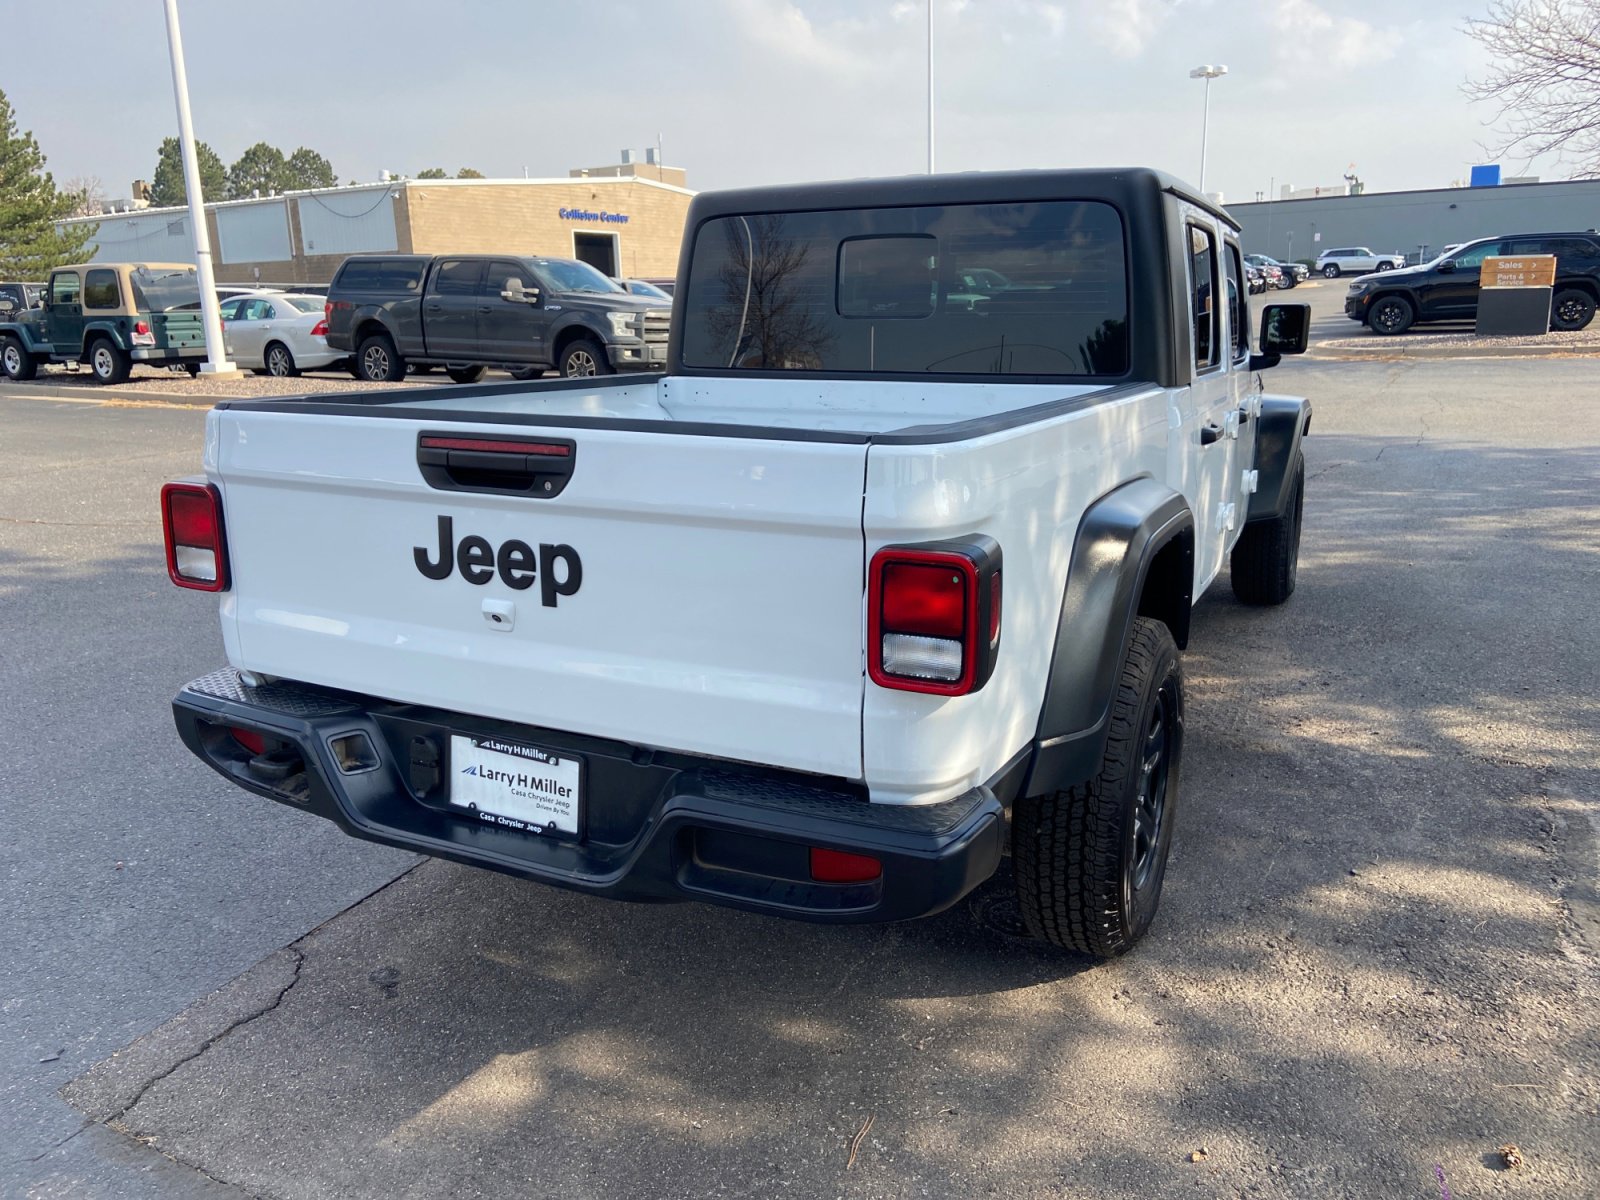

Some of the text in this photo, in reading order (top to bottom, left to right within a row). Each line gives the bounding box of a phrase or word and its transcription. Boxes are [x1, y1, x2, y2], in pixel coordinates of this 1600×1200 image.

[559, 208, 629, 223] Collision Center
[1498, 261, 1523, 269] Sales
[413, 514, 583, 608] Jeep
[491, 740, 548, 760] Larry H Miller
[479, 765, 572, 798] Larry H Miller
[511, 788, 570, 809] Casa Chrysler Jeep
[536, 803, 570, 816] Driven By You
[479, 812, 542, 833] Casa Chrysler Jeep
